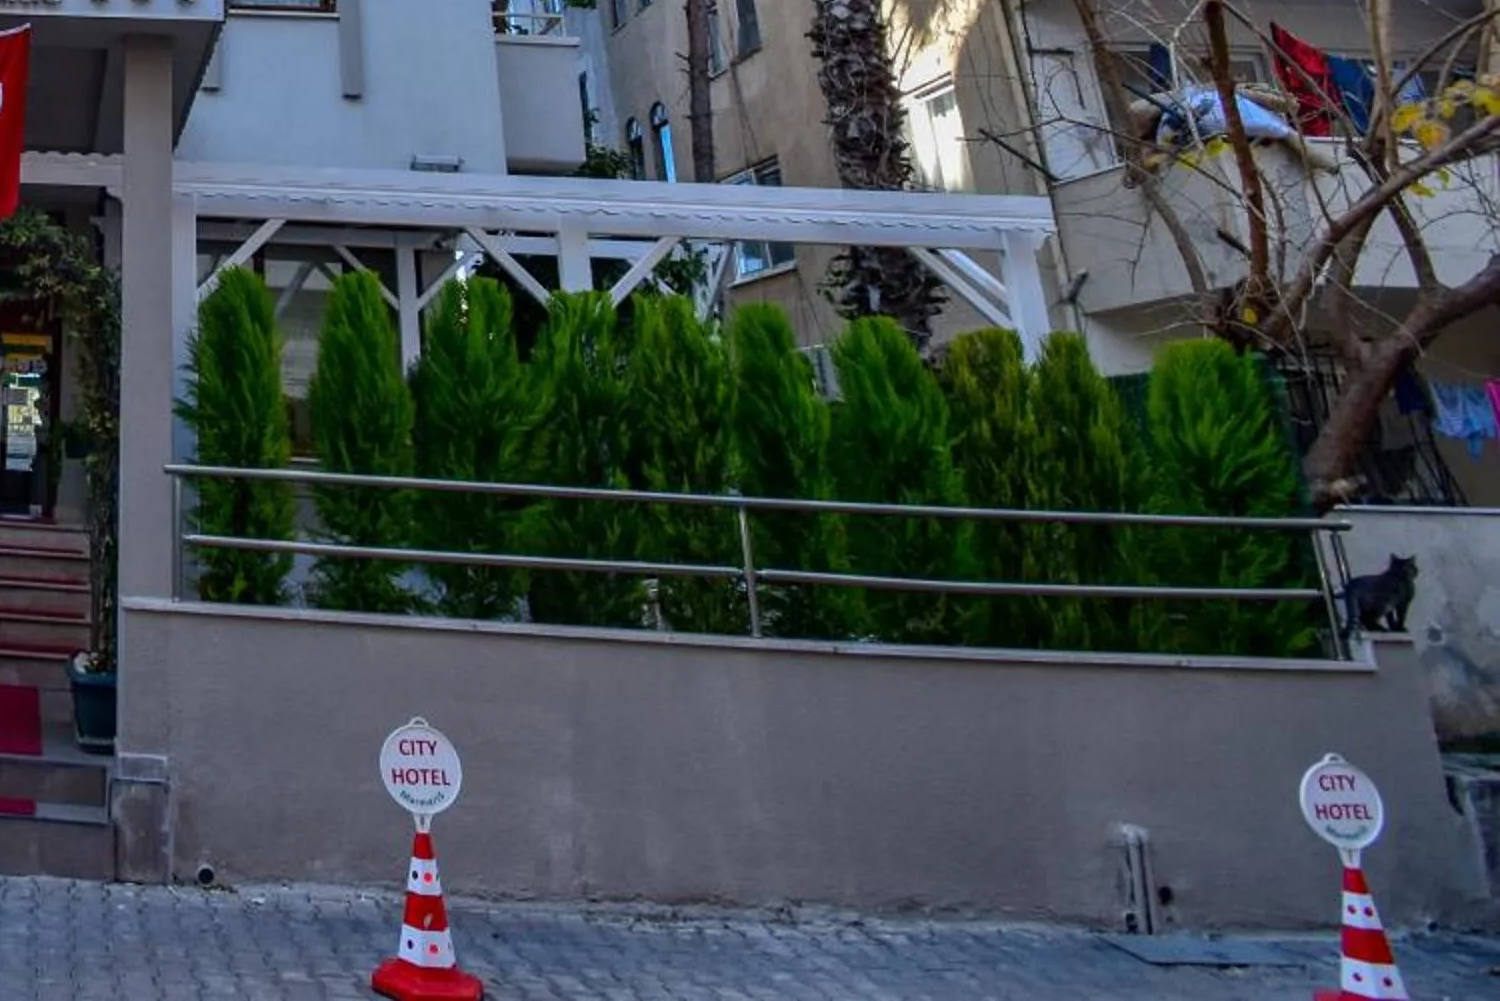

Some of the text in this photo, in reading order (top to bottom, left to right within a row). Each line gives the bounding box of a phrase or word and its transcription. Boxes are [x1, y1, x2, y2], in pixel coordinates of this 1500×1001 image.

[399, 739, 437, 756] CITY
[391, 768, 451, 786] HOTEL
[1318, 774, 1356, 791] CITY
[1314, 803, 1374, 821] HOTEL
